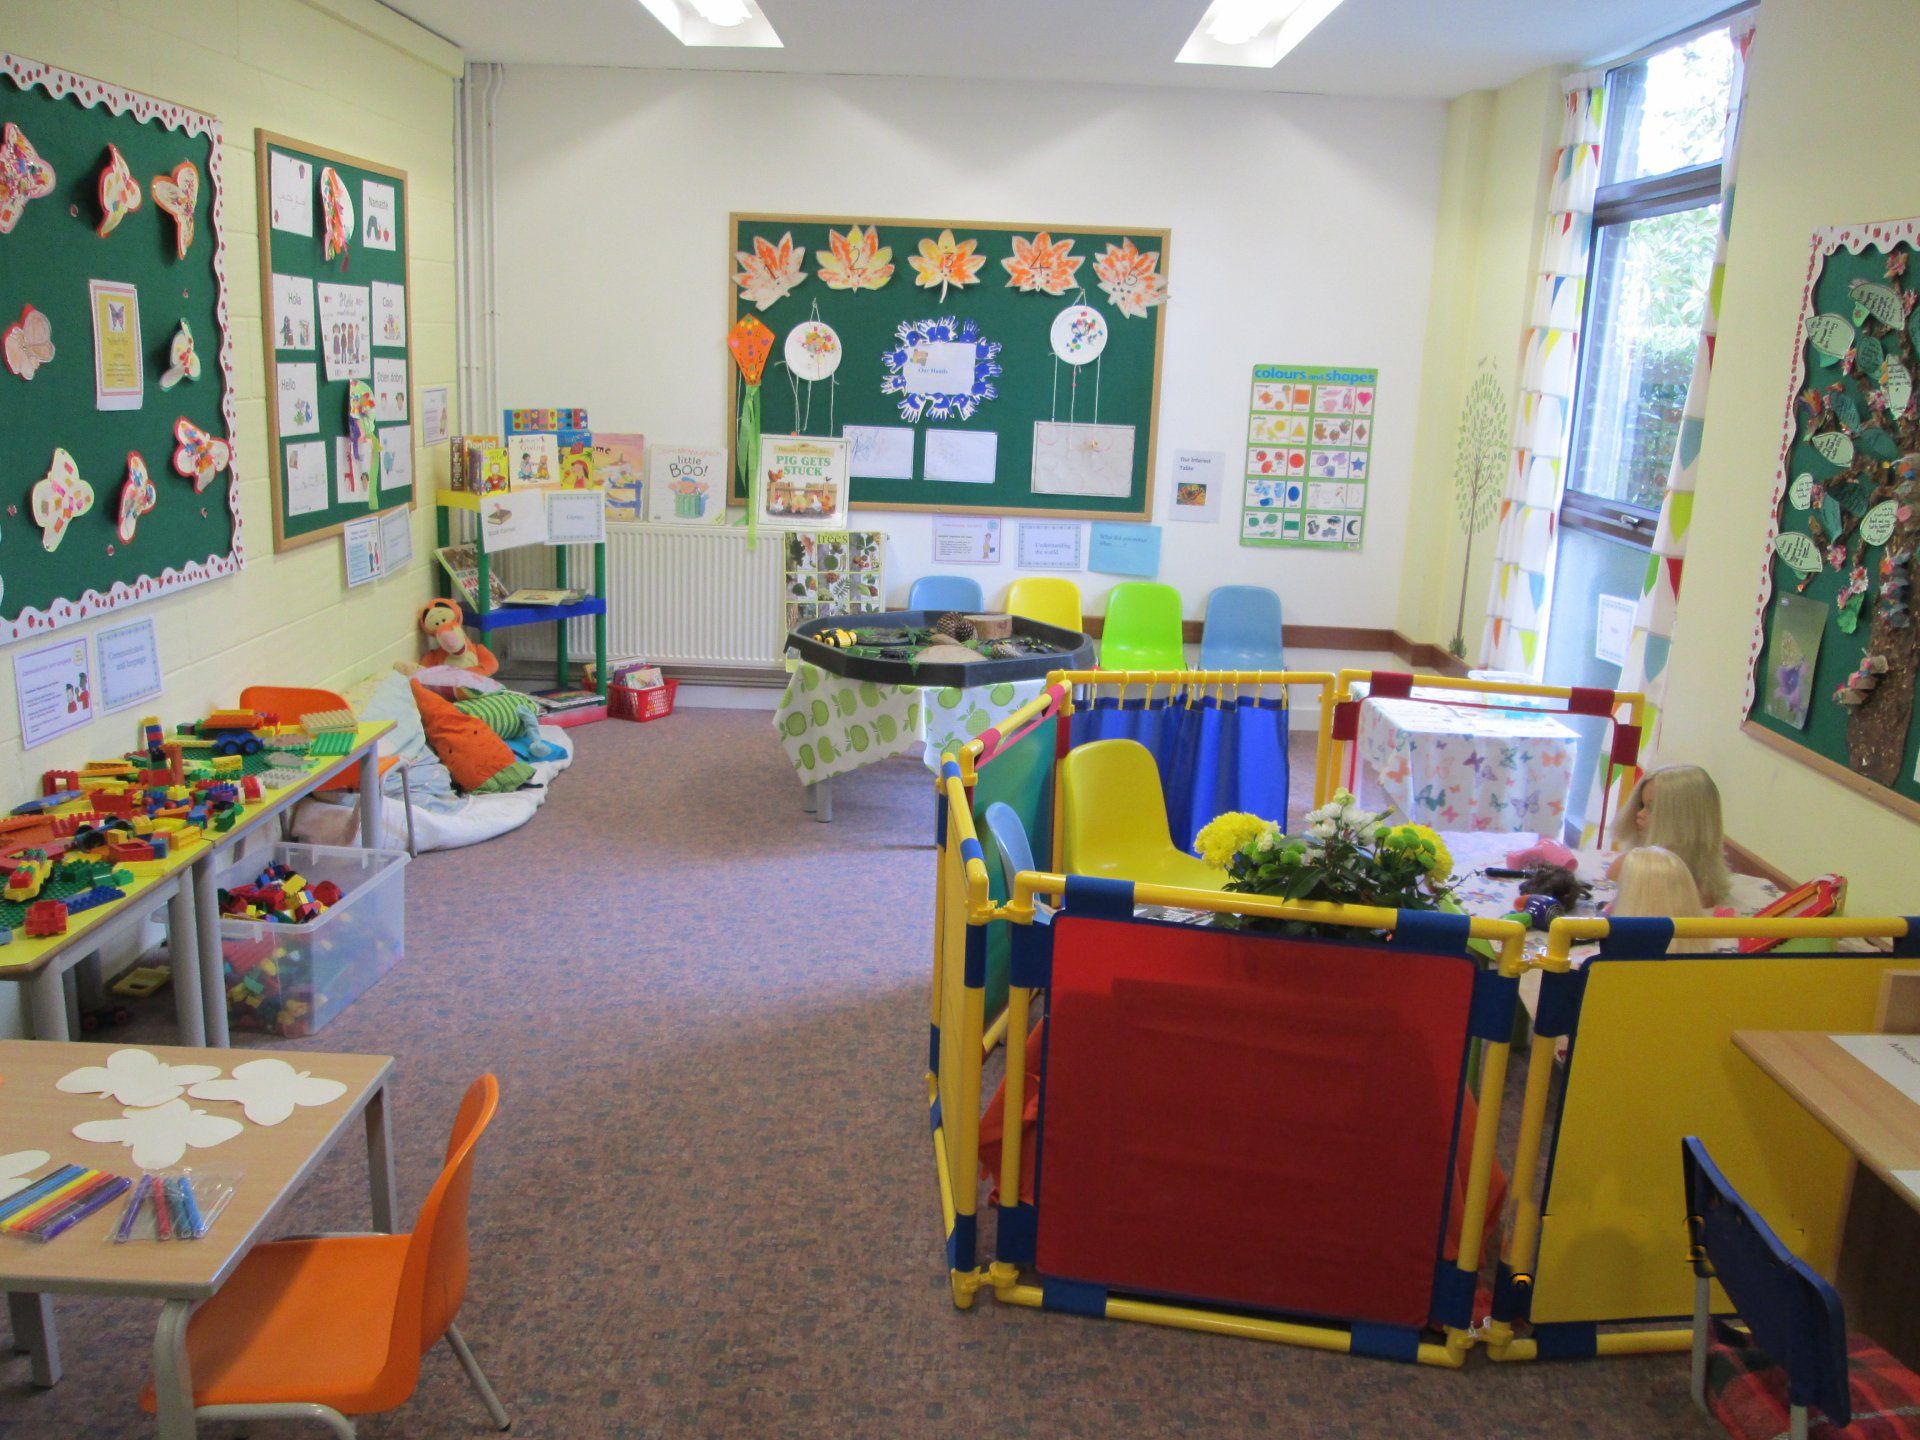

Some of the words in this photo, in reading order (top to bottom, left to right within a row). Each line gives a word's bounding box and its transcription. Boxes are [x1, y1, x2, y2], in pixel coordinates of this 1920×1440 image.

[288, 293, 302, 305] Hola
[1255, 367, 1306, 380] colours
[1325, 370, 1375, 385] shapes
[281, 379, 296, 391] Hello
[776, 455, 798, 465] PIG
[801, 456, 831, 467] GETS
[783, 465, 823, 477] STUCK
[817, 534, 848, 543] trees
